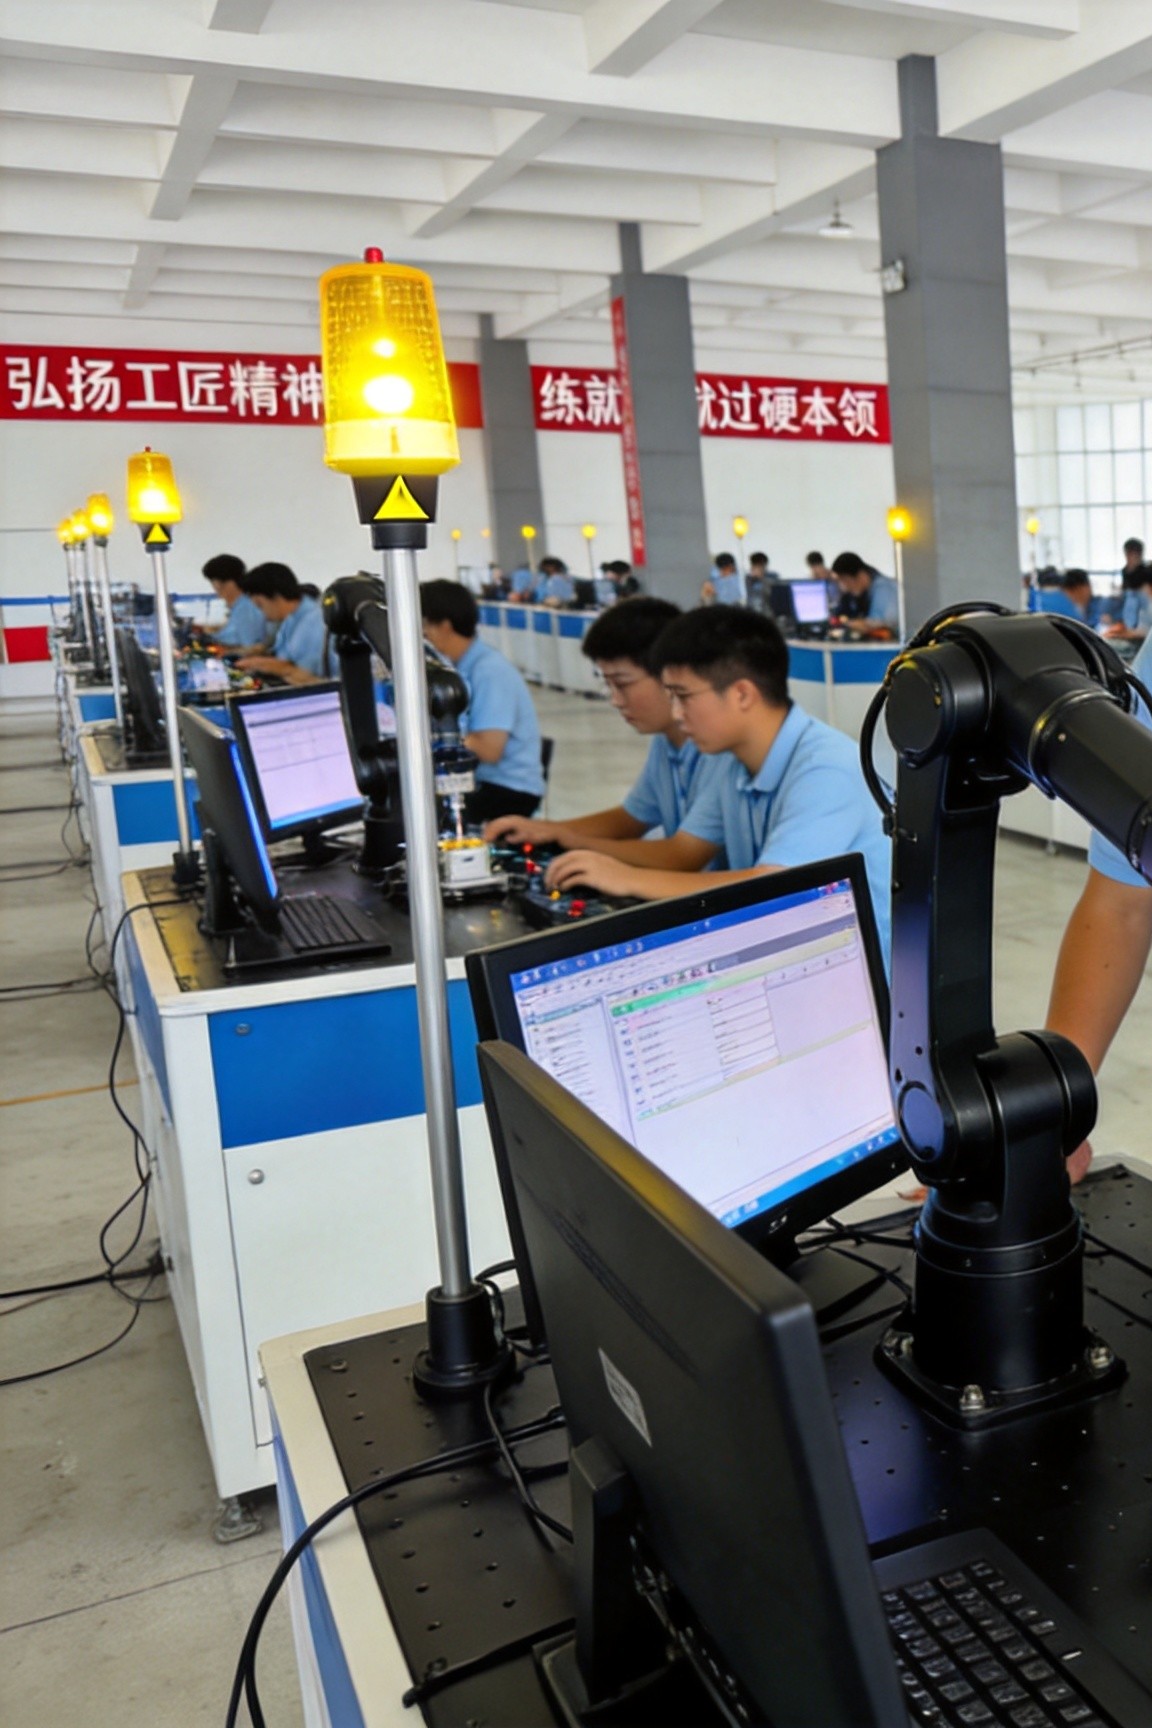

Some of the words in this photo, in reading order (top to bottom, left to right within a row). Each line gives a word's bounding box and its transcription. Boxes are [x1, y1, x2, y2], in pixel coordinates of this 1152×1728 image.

[5, 356, 324, 421] 弘扬工匠精神
[539, 371, 623, 427] 练就
